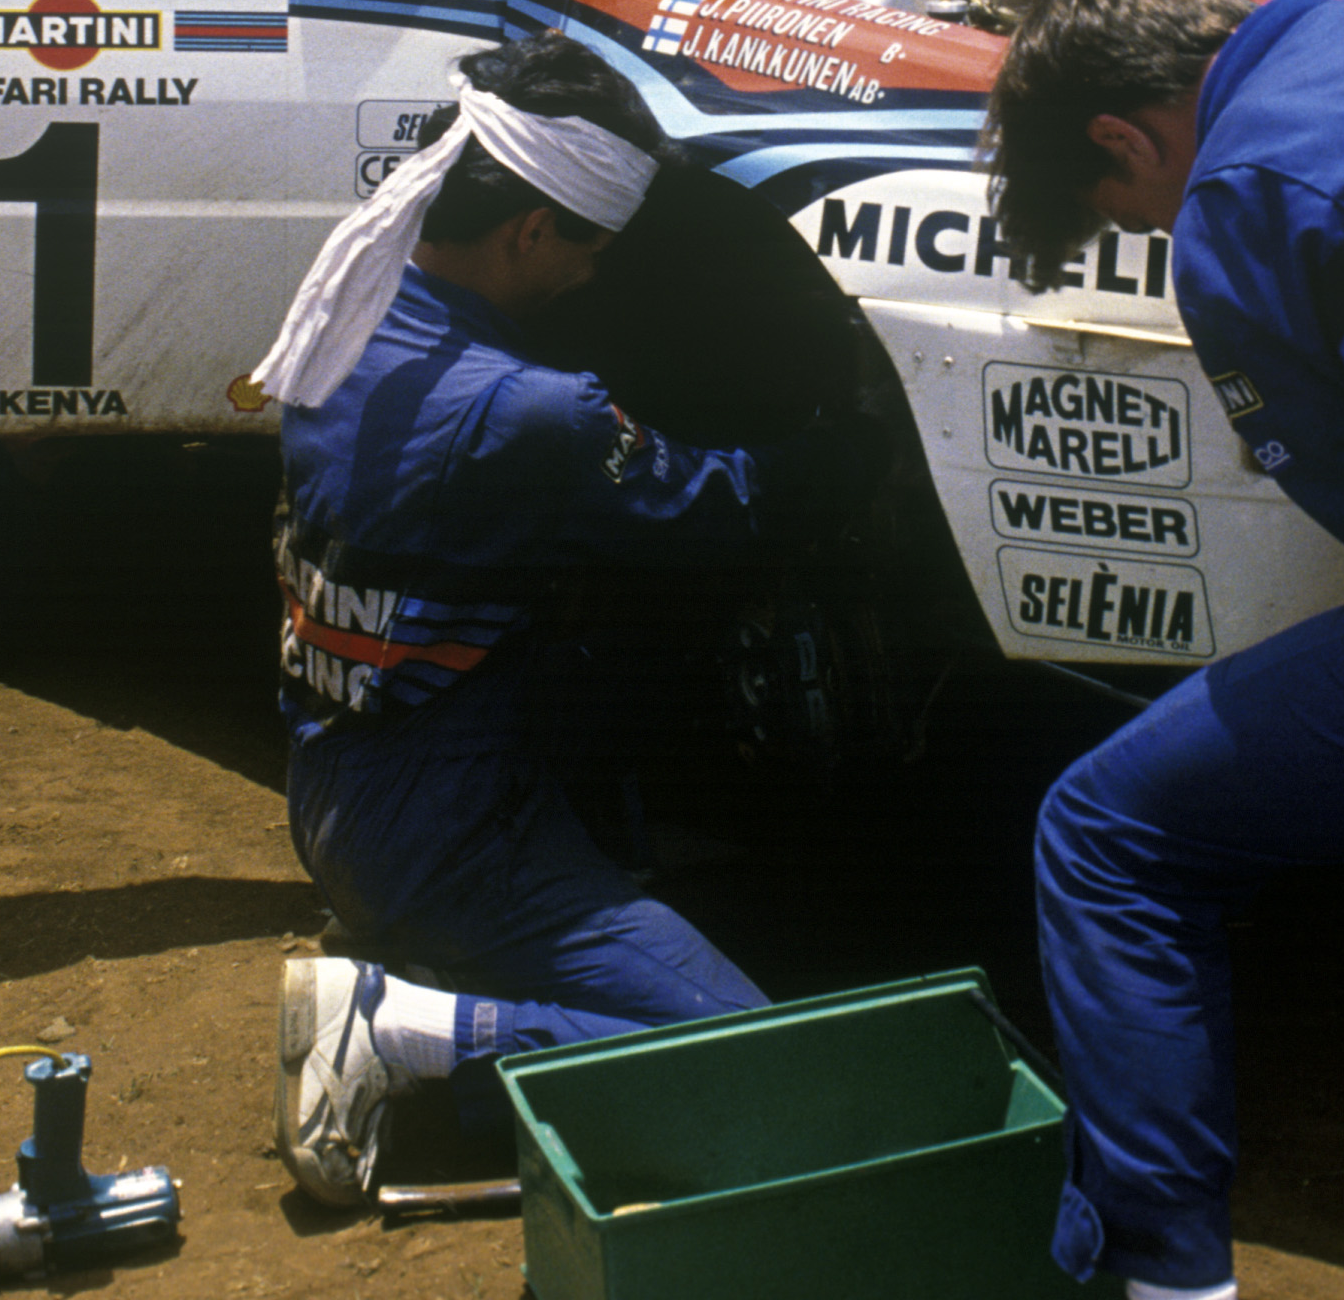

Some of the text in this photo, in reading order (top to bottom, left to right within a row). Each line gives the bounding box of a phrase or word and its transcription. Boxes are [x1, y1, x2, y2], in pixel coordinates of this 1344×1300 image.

[838, 0, 950, 37] RACING
[79, 77, 199, 106] RALLY
[992, 374, 1181, 445] MAGNETI
[992, 405, 1181, 475] MARELLI
[997, 490, 1189, 547] WEBER
[1019, 561, 1195, 643] SELÈNIA
[1116, 634, 1192, 651] MOTOR OIL
